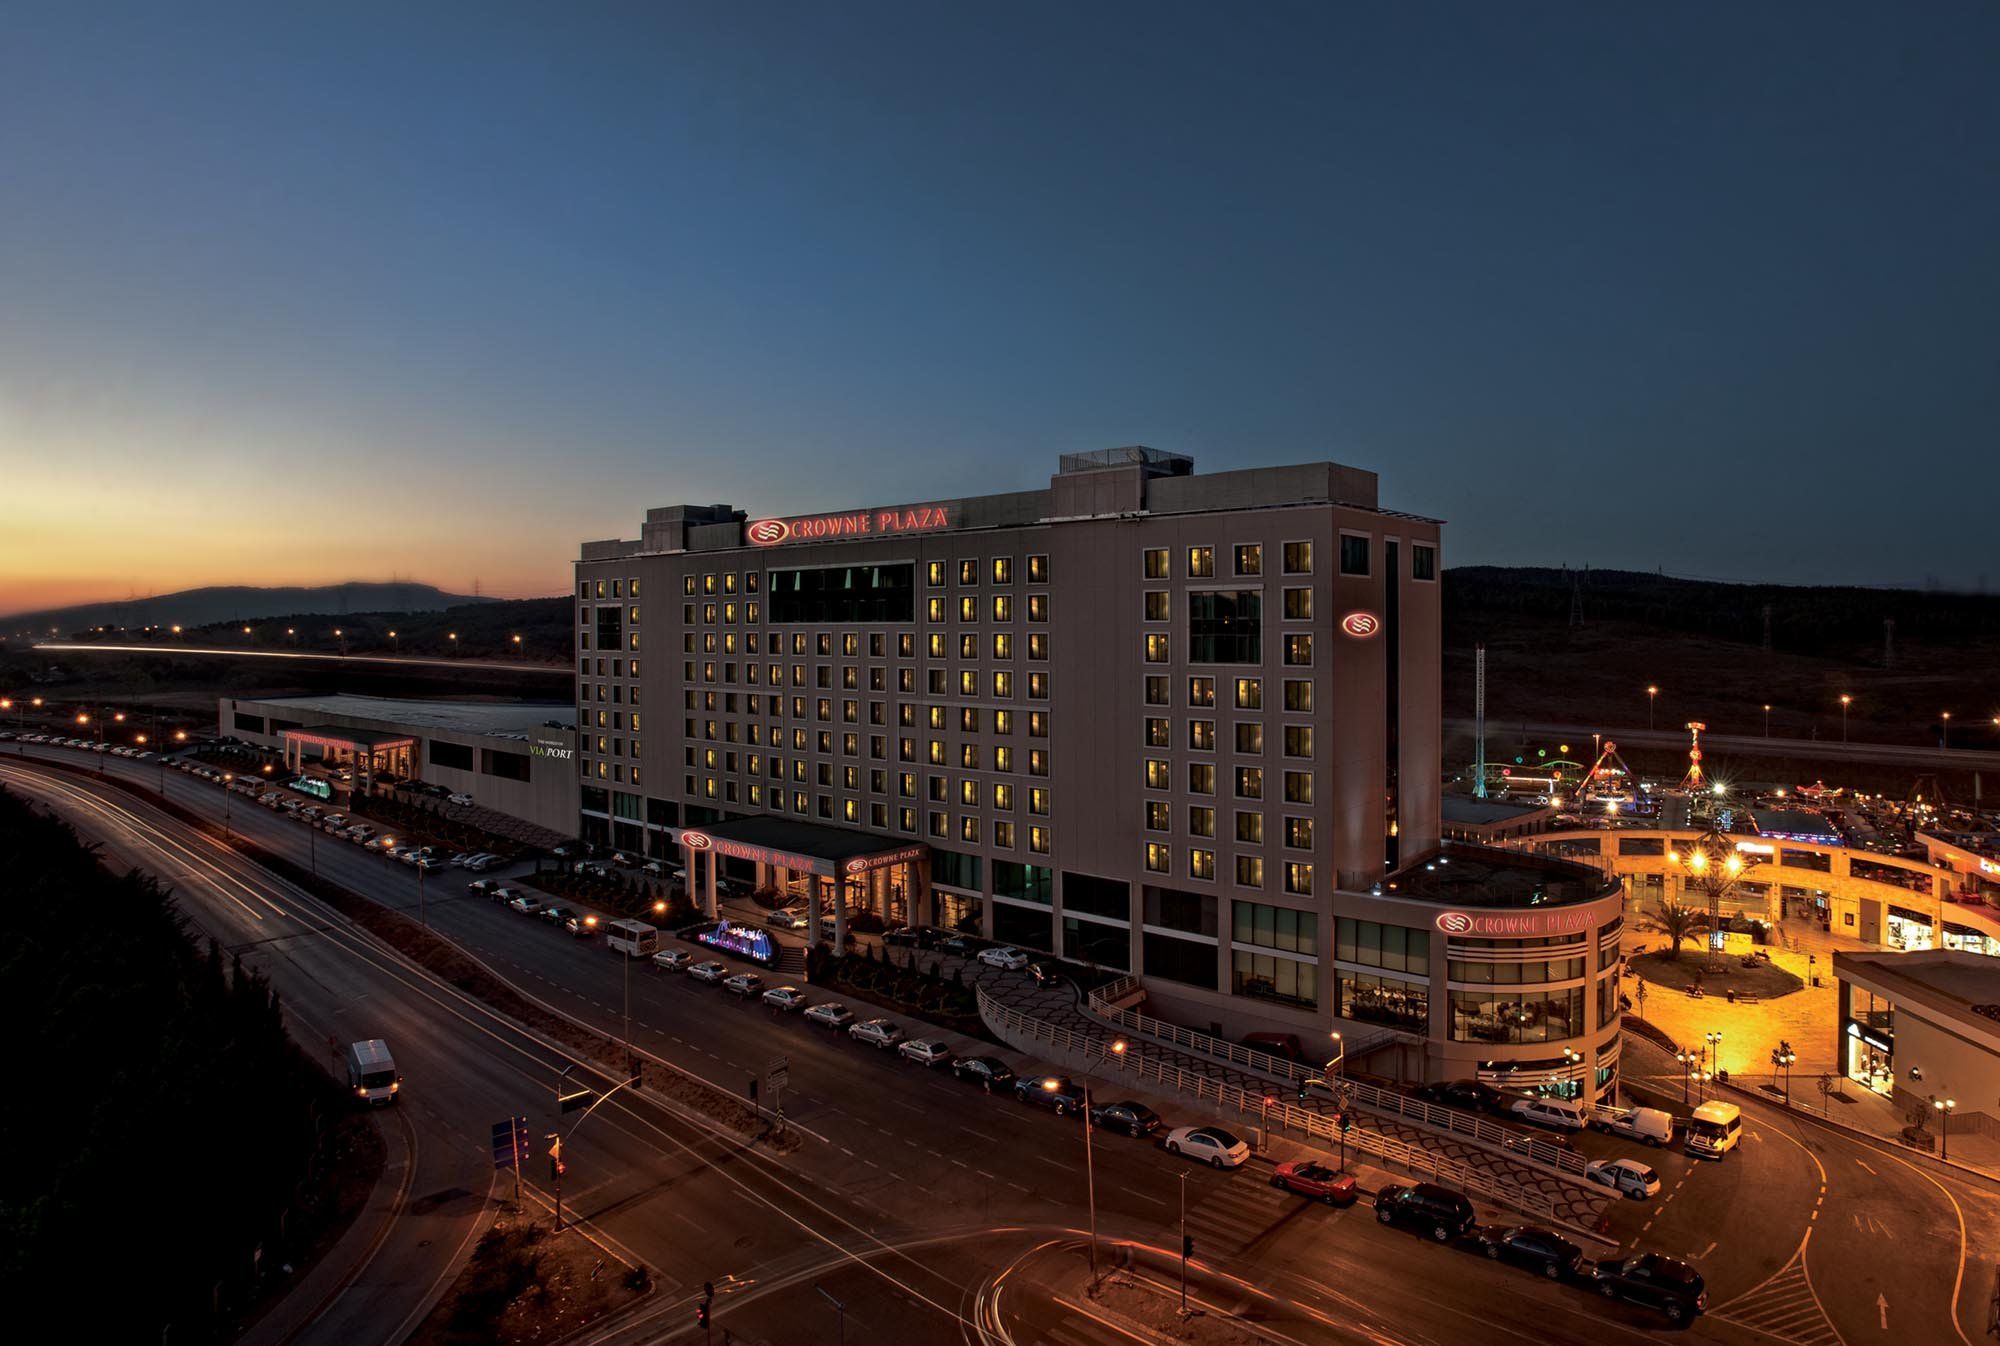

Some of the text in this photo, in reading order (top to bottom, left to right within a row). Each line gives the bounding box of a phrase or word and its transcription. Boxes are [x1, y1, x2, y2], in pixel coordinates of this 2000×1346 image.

[791, 507, 949, 538] CROWNE PLAZA
[868, 849, 920, 867] CROWNE PLAZA
